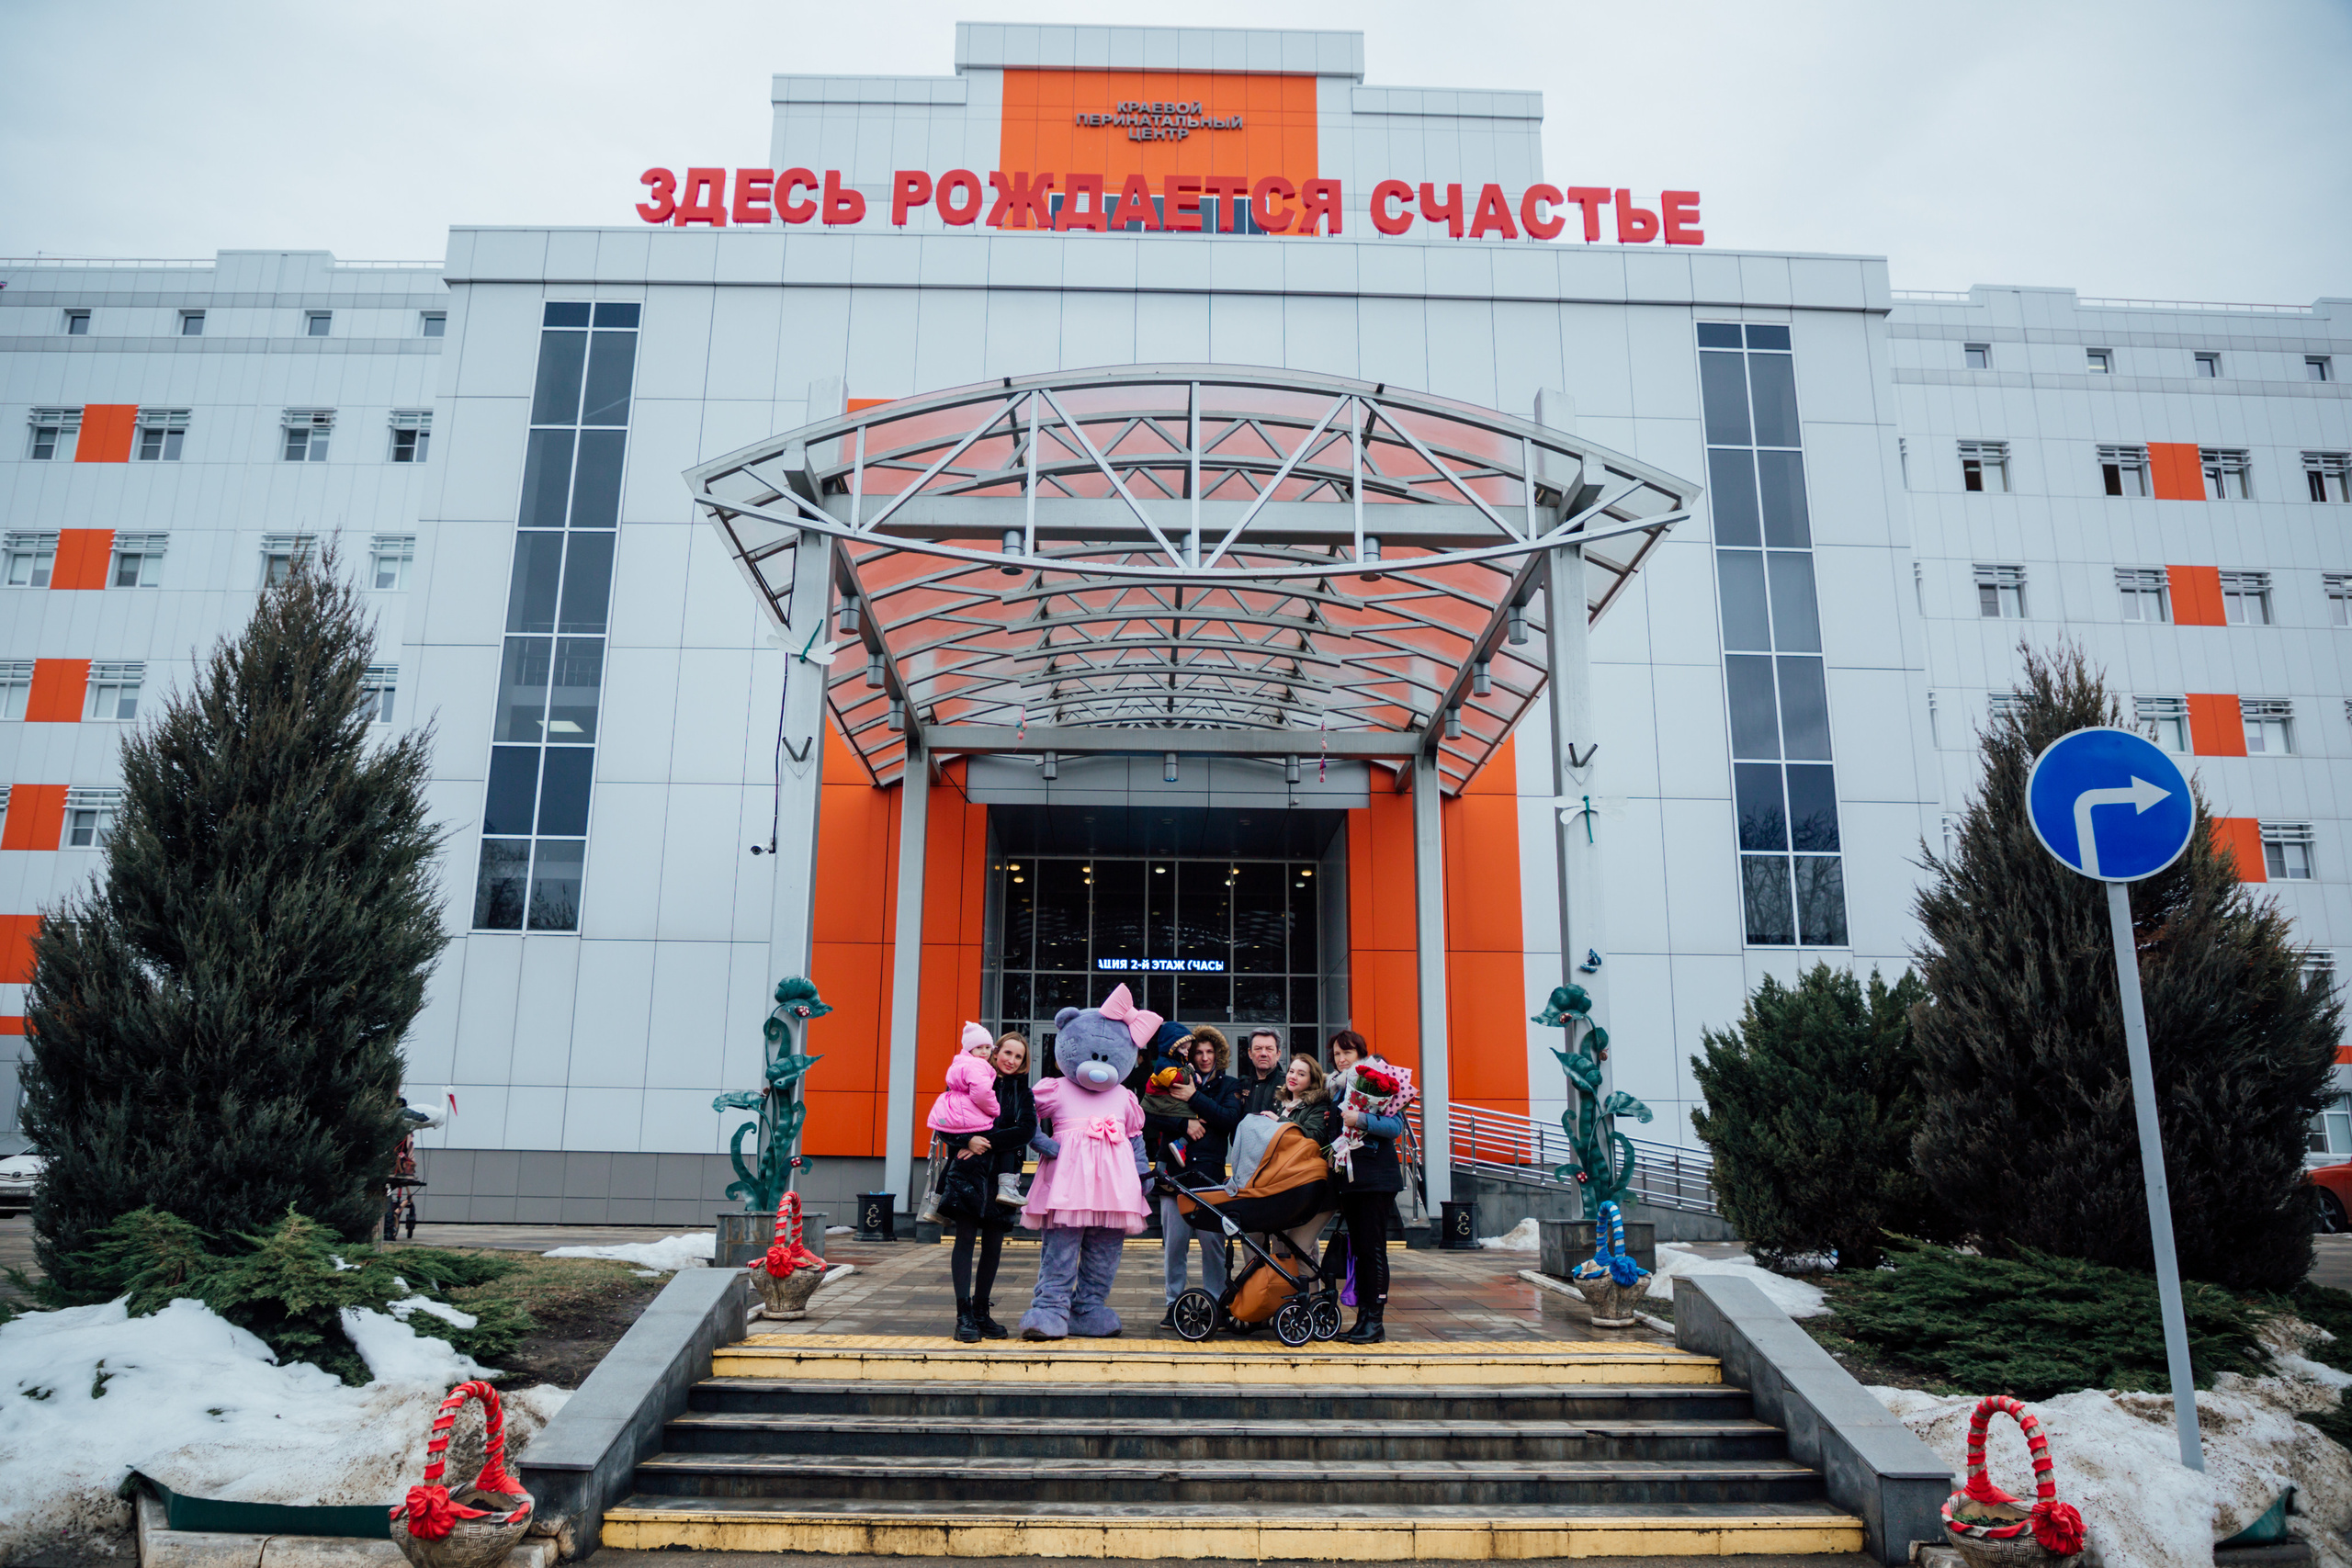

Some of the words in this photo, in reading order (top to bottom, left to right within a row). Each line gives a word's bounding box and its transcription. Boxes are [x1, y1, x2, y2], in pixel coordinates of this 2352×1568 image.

[1116, 101, 1203, 116] КРАЕВОЙ
[1076, 113, 1243, 130] ПЕРИНАТАЛЬНЫЙ
[1128, 127, 1190, 142] ЦЕНТР
[635, 166, 866, 228] ЗДЕСЬ
[891, 168, 1342, 235] РОЖДАЕТСЯ
[1370, 179, 1705, 246] СЧАСТЬЕ
[1151, 959, 1186, 971] ЭТАЖ
